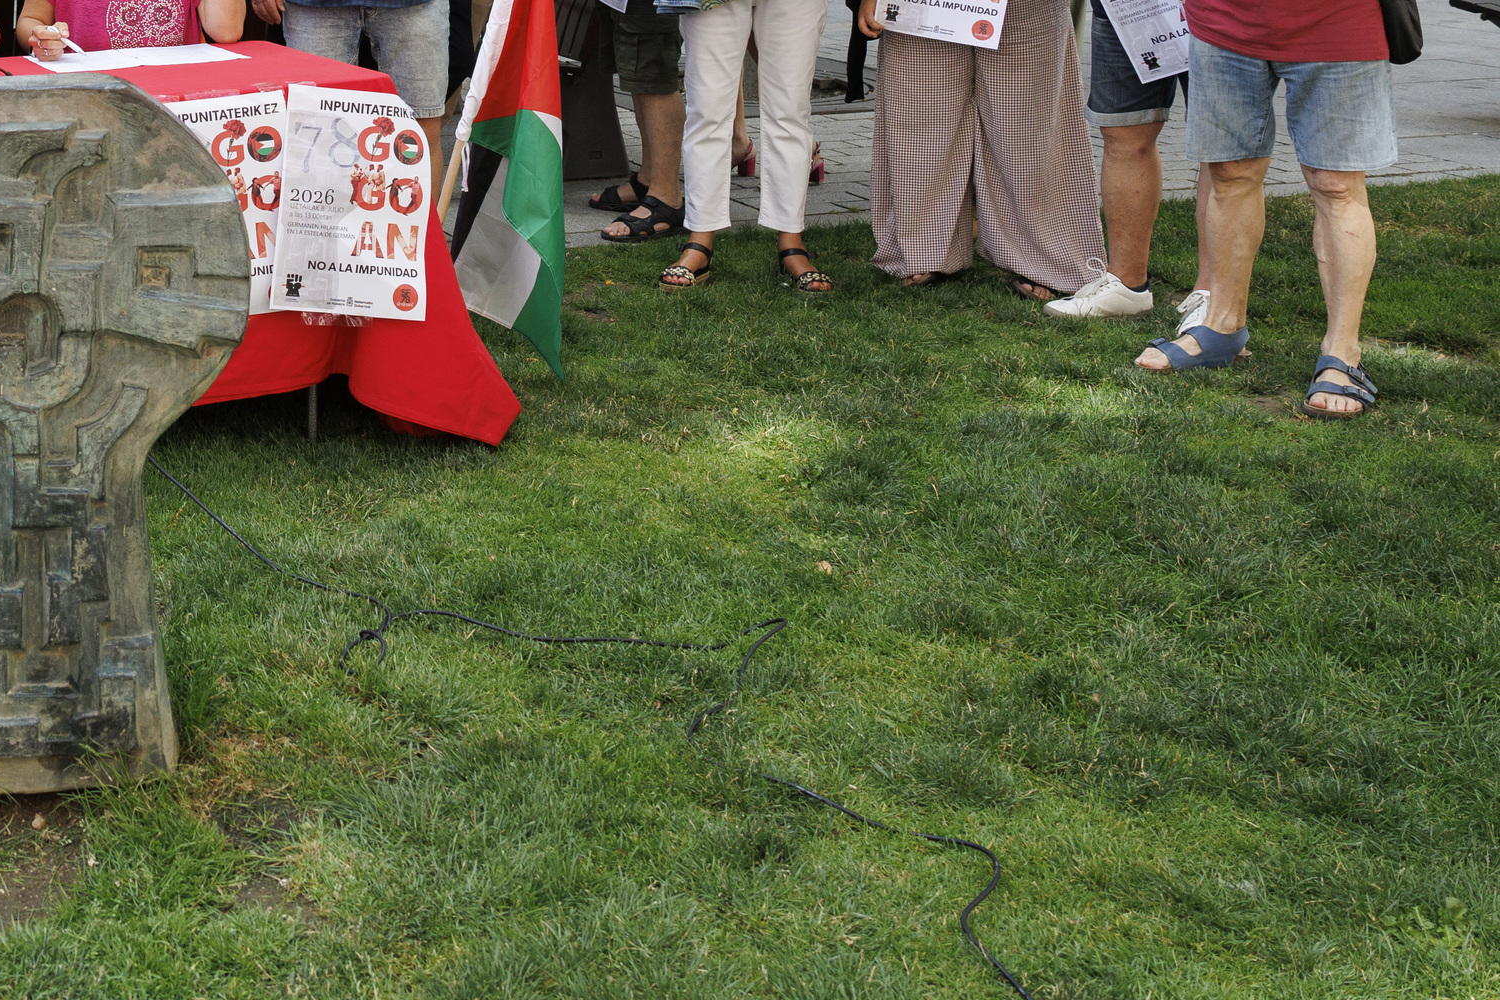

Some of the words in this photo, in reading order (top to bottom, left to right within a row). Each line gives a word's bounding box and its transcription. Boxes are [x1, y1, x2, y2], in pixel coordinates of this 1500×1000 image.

[929, 0, 941, 7] LA
[942, 1, 998, 16] IMPUNIDAD
[1150, 33, 1169, 45] NO
[1167, 31, 1177, 40] A
[1176, 27, 1190, 37] LA
[320, 99, 411, 119] INPUNITATERIK
[290, 185, 335, 205] 2026
[307, 260, 327, 270] NO
[328, 262, 337, 271] A
[339, 263, 353, 273] LA
[355, 264, 417, 278] IMPUNIDAD
